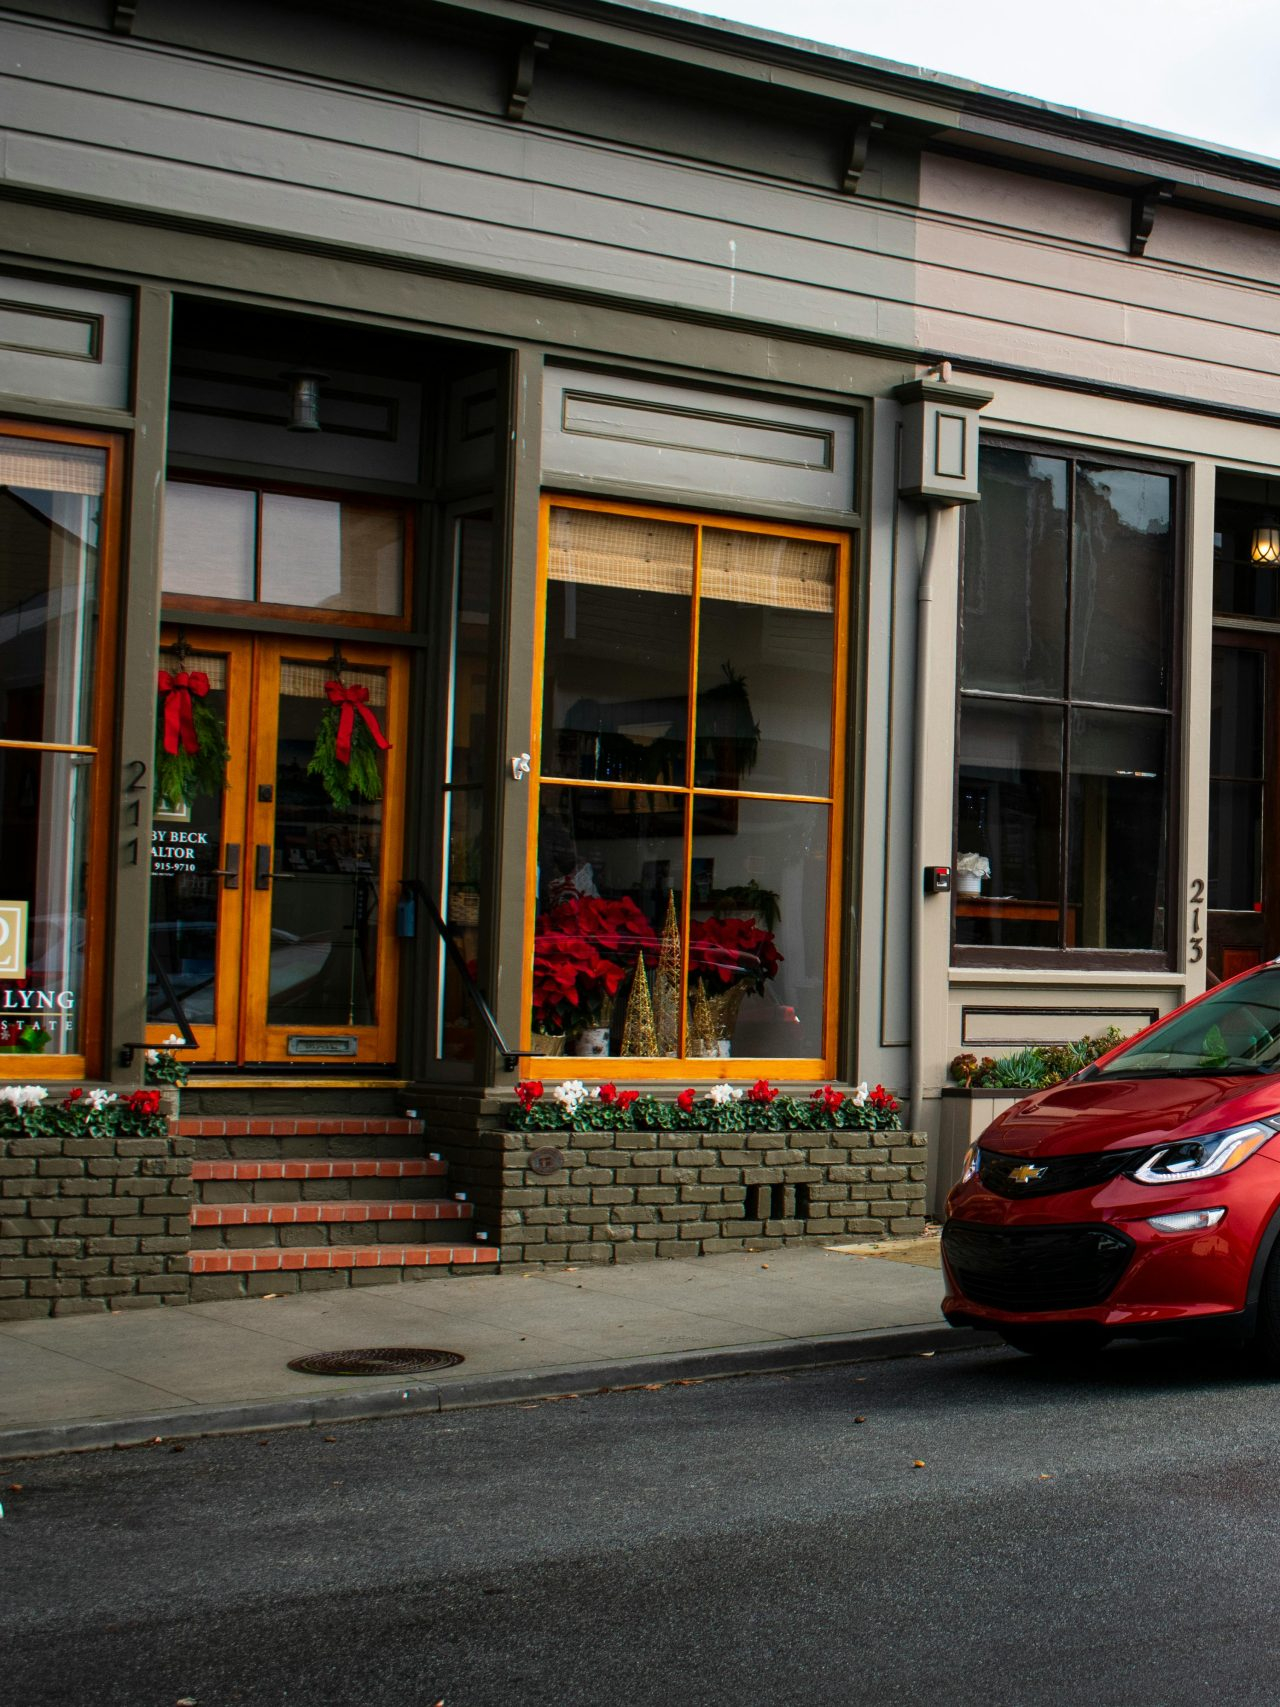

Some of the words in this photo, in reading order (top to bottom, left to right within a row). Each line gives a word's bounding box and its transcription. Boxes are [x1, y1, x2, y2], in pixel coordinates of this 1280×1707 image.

[128, 760, 147, 866] 211
[170, 831, 208, 844] BECK
[154, 862, 196, 872] 915-9710
[1189, 878, 1205, 964] 213
[3, 989, 75, 1009] LYNG
